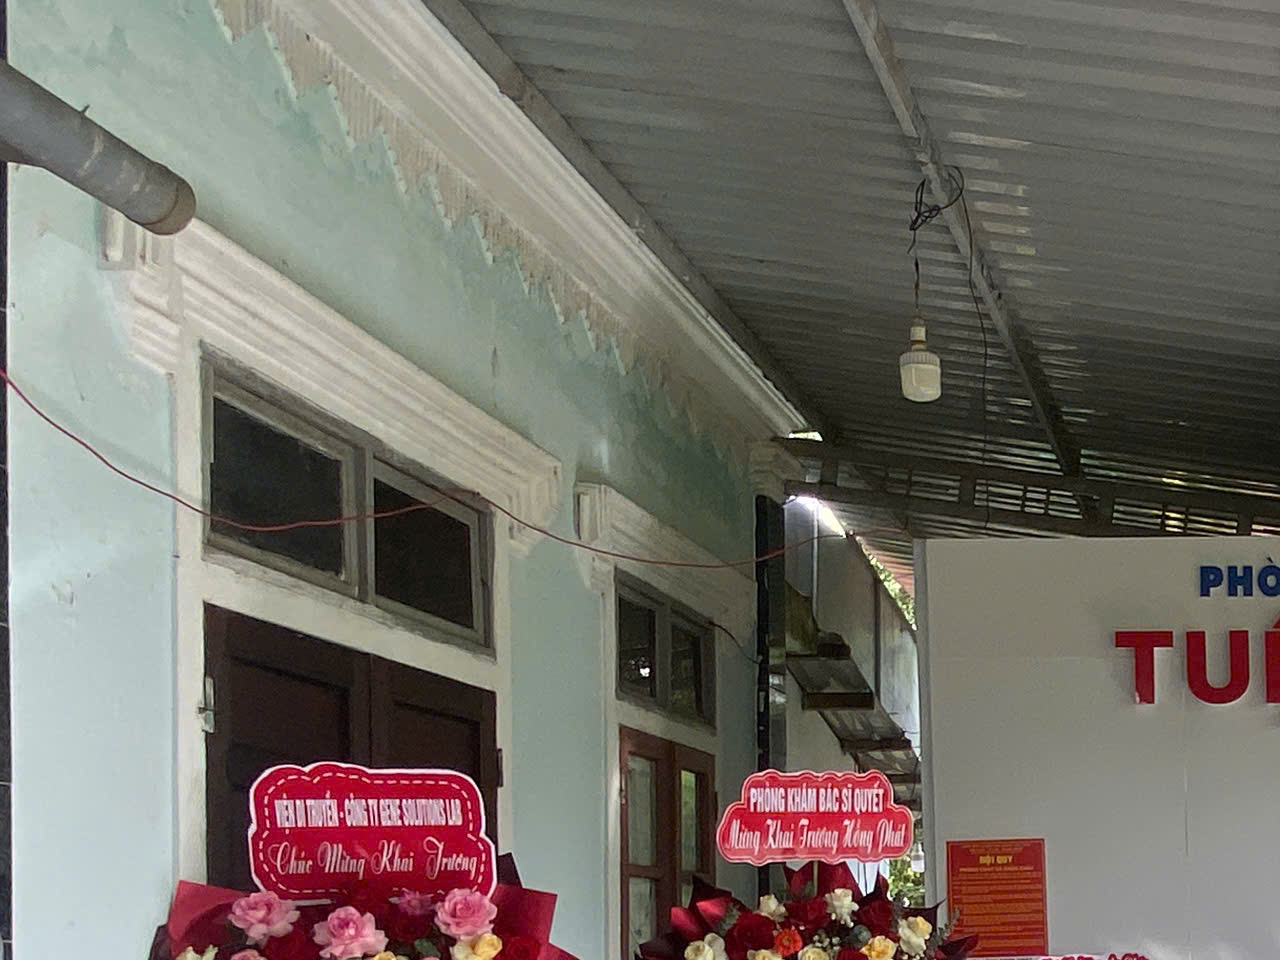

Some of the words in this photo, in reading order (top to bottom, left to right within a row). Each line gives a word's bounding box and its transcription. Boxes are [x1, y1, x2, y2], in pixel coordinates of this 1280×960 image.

[750, 782, 785, 813] PHÒNG
[787, 782, 816, 813] KHÁM
[819, 782, 840, 813] BÁC
[854, 780, 885, 815] QUYẾT
[727, 819, 760, 855] Mừng
[764, 819, 794, 849] Khai
[267, 841, 313, 875] Chúc
[317, 841, 365, 880] Mừng
[371, 839, 414, 874] Khai
[423, 836, 477, 880] Trương
